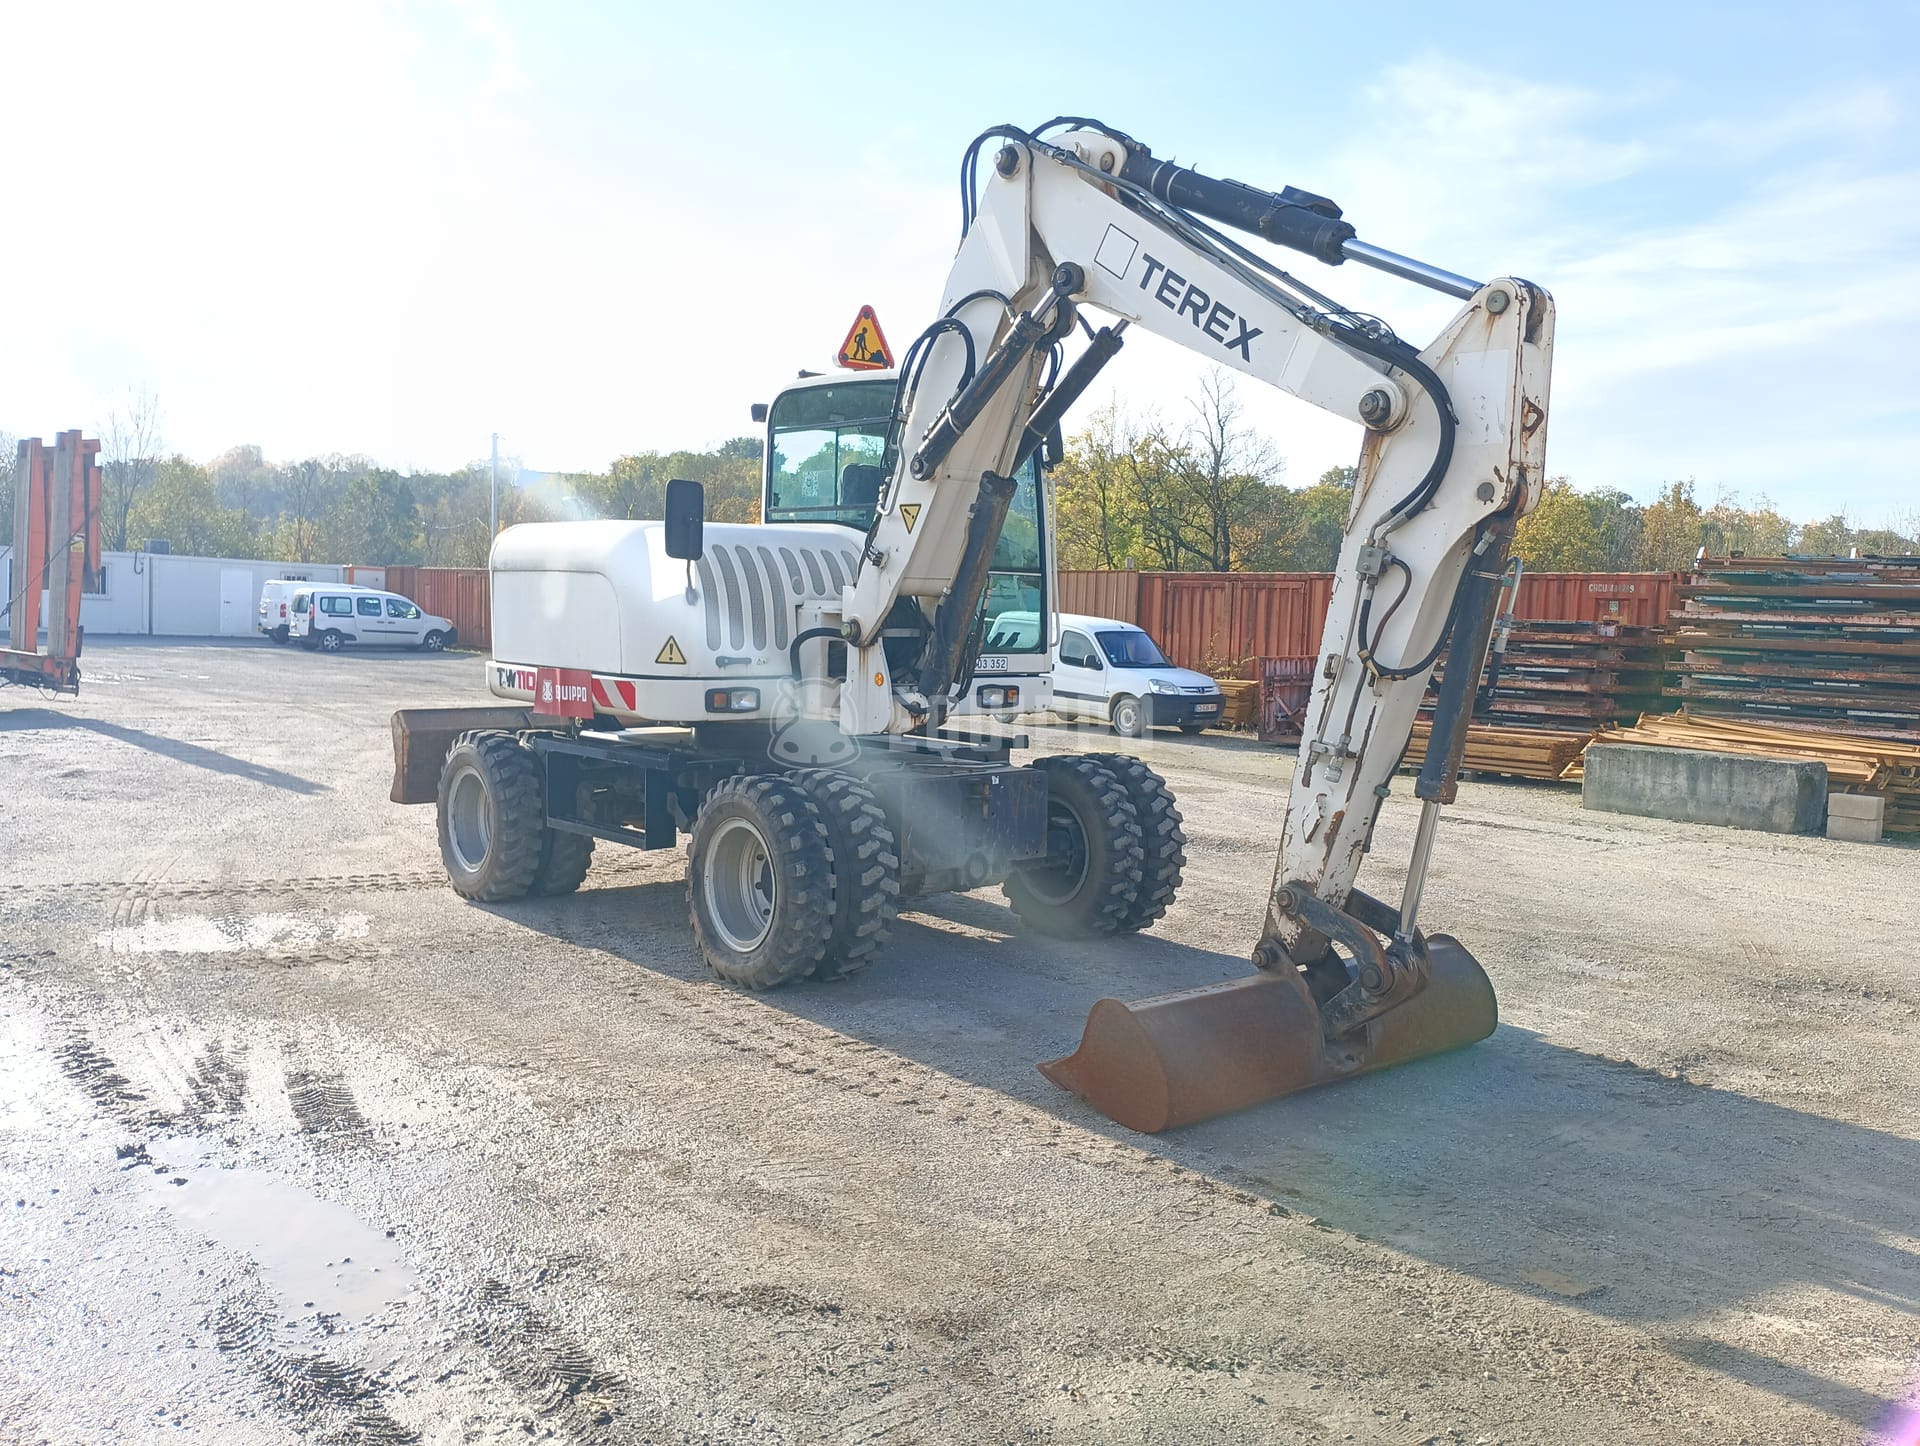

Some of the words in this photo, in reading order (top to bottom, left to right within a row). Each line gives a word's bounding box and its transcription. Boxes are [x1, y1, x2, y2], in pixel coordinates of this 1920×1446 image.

[1139, 252, 1264, 363] TEREX
[990, 658, 1006, 669] 352
[497, 667, 536, 691] TW110
